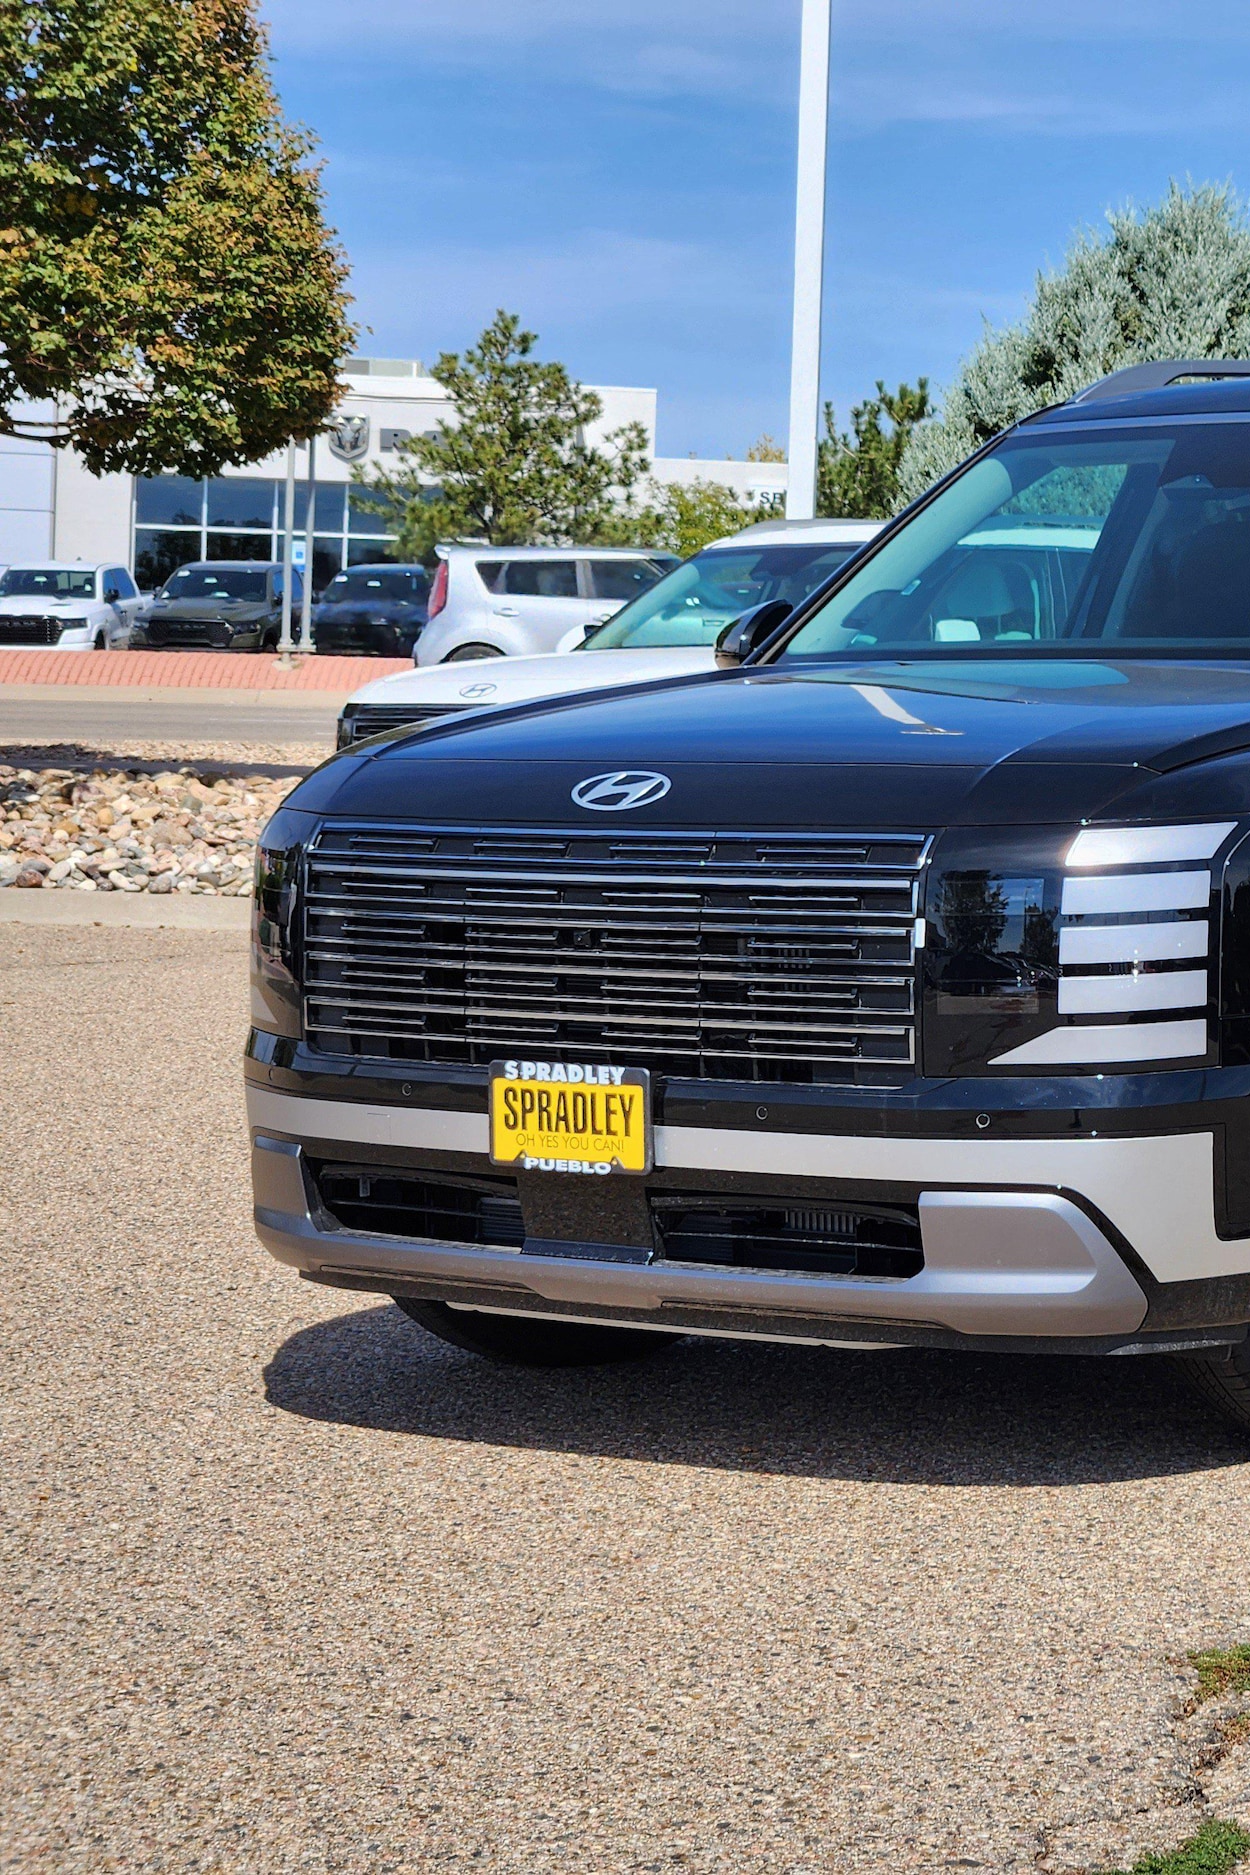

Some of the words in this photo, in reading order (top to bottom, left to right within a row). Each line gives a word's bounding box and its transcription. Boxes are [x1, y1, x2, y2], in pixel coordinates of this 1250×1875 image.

[504, 1061, 626, 1086] SPRADLEY
[504, 1087, 635, 1137] SPRADLEY
[516, 1133, 535, 1147] OH
[539, 1135, 559, 1149] YES
[564, 1136, 589, 1151] YOU
[593, 1138, 625, 1153] CAN!
[524, 1156, 612, 1175] PUEBLO
